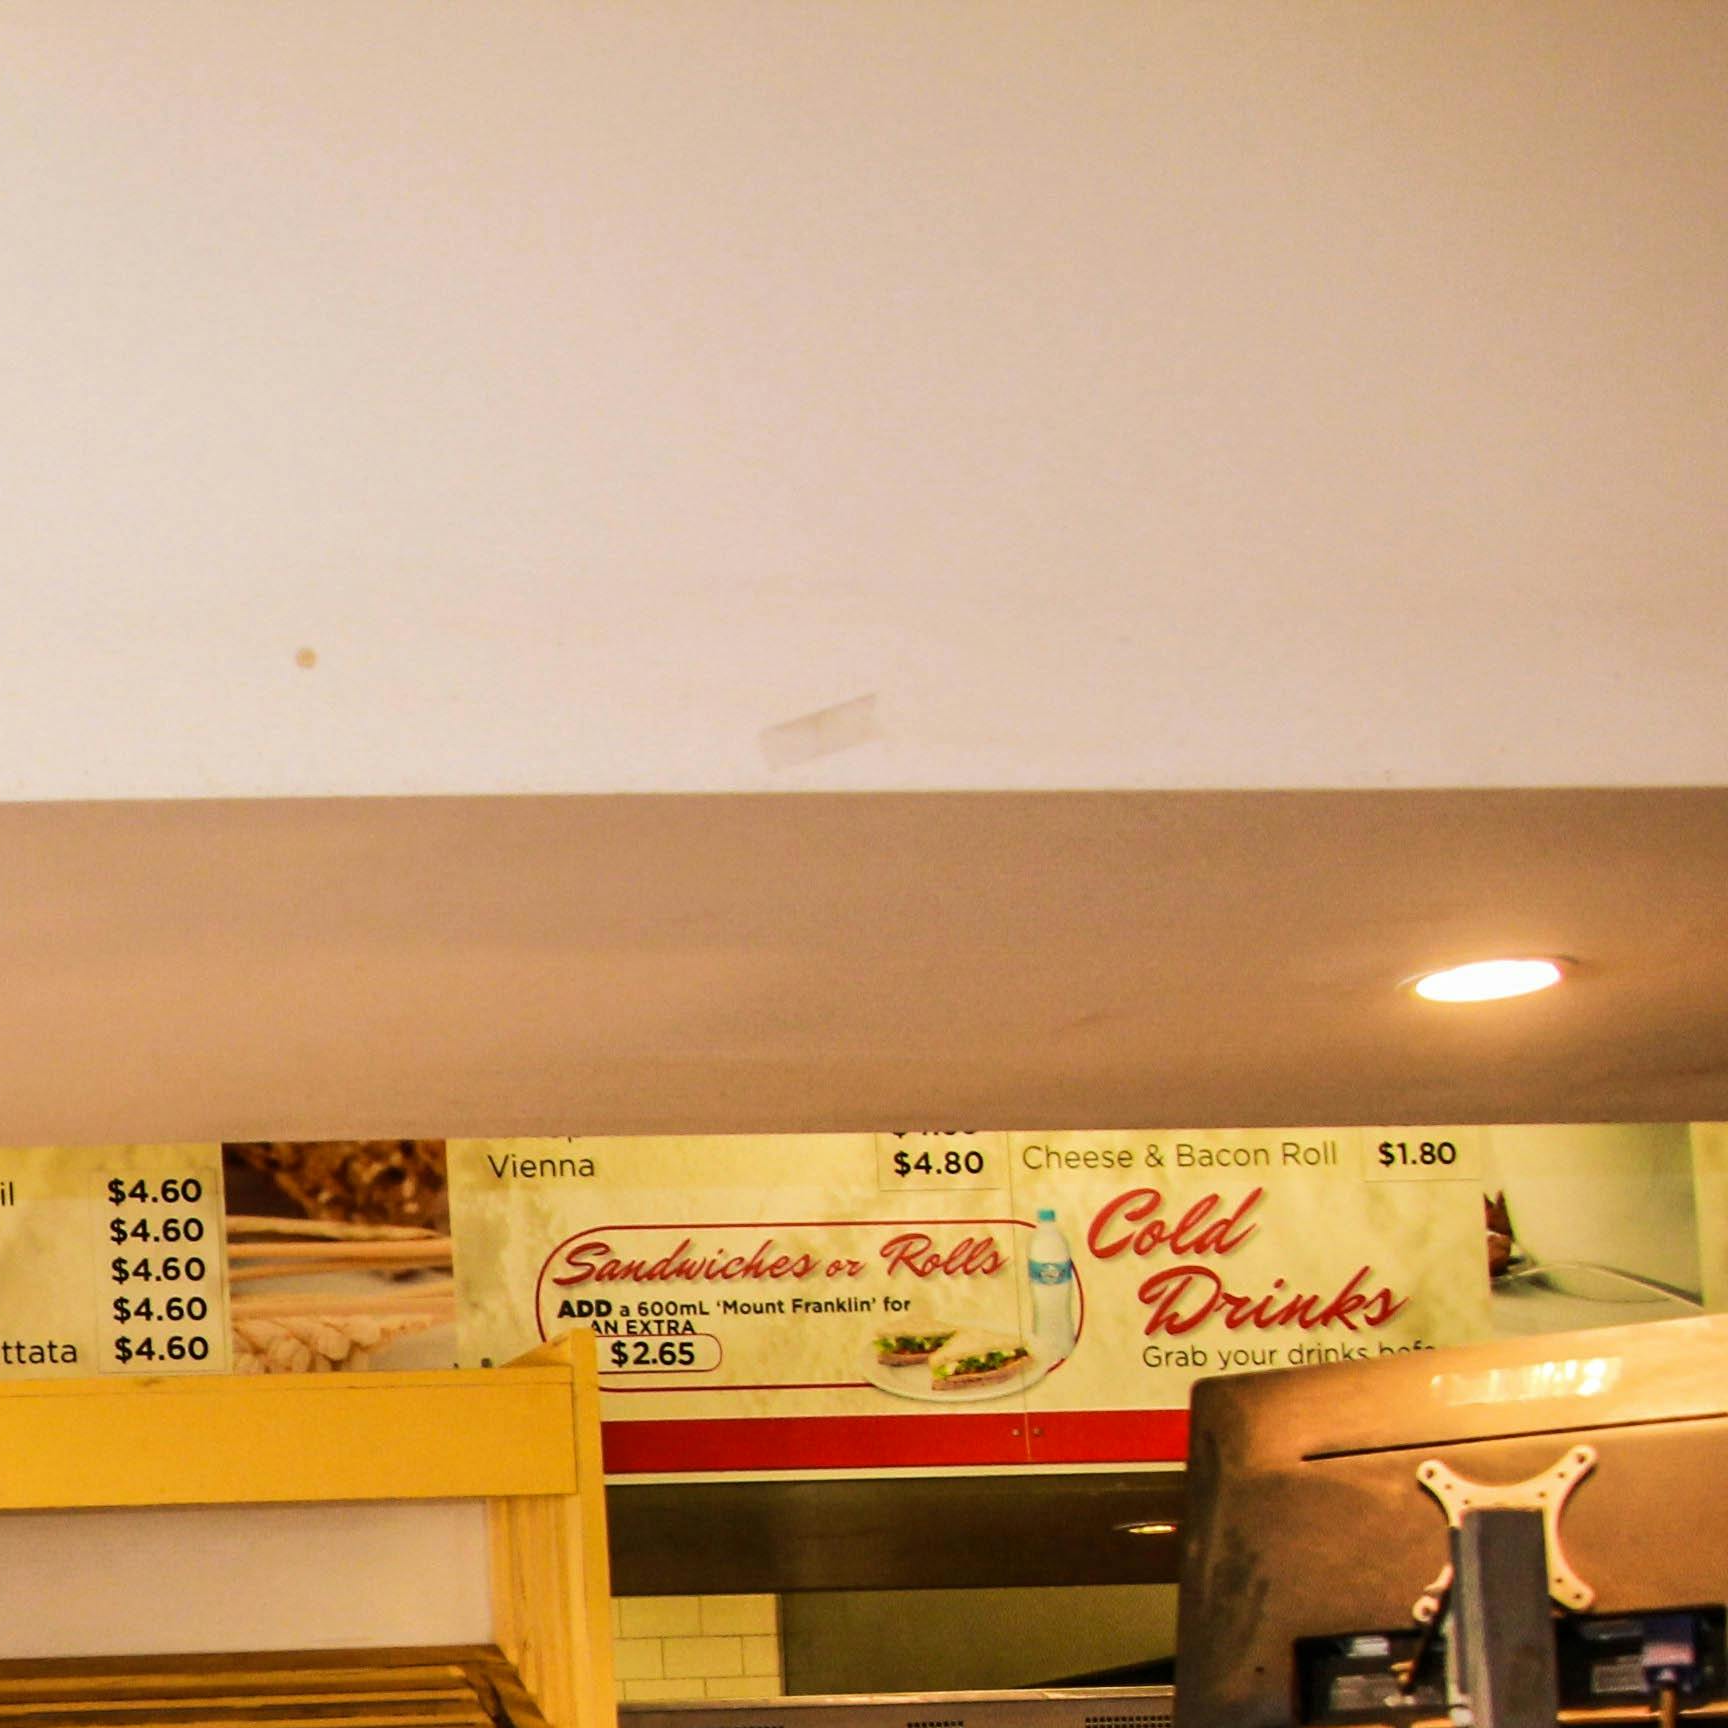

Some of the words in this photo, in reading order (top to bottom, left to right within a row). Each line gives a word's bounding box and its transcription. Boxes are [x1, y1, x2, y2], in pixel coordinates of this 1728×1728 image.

[487, 1153, 595, 1179] Vienna
[893, 1150, 984, 1177] $4.80
[1022, 1144, 1133, 1170] Cheese
[1145, 1144, 1164, 1168] &
[1176, 1143, 1270, 1168] Bacon
[1282, 1140, 1337, 1166] Roll
[1377, 1141, 1457, 1167] $1.80
[107, 1178, 203, 1206] $4.60
[109, 1217, 204, 1245] $4.60
[1087, 1187, 1263, 1260] Cold
[111, 1256, 206, 1285] $4.60
[552, 1237, 821, 1286] Sandwiches
[826, 1255, 864, 1278] or
[879, 1232, 1010, 1279] Rolls
[112, 1296, 208, 1324] $4.60
[557, 1299, 612, 1319] ADD
[619, 1304, 630, 1317] a
[637, 1301, 710, 1317] 600mL
[883, 1295, 911, 1313] for
[1137, 1265, 1409, 1337] Drinks
[591, 1320, 618, 1334] AN
[626, 1320, 696, 1335] EXTRA
[114, 1335, 209, 1364] $4.60
[610, 1340, 695, 1368] $2.65
[1143, 1344, 1207, 1368] Grab
[1218, 1348, 1277, 1370] your
[1288, 1343, 1368, 1366] drinks
